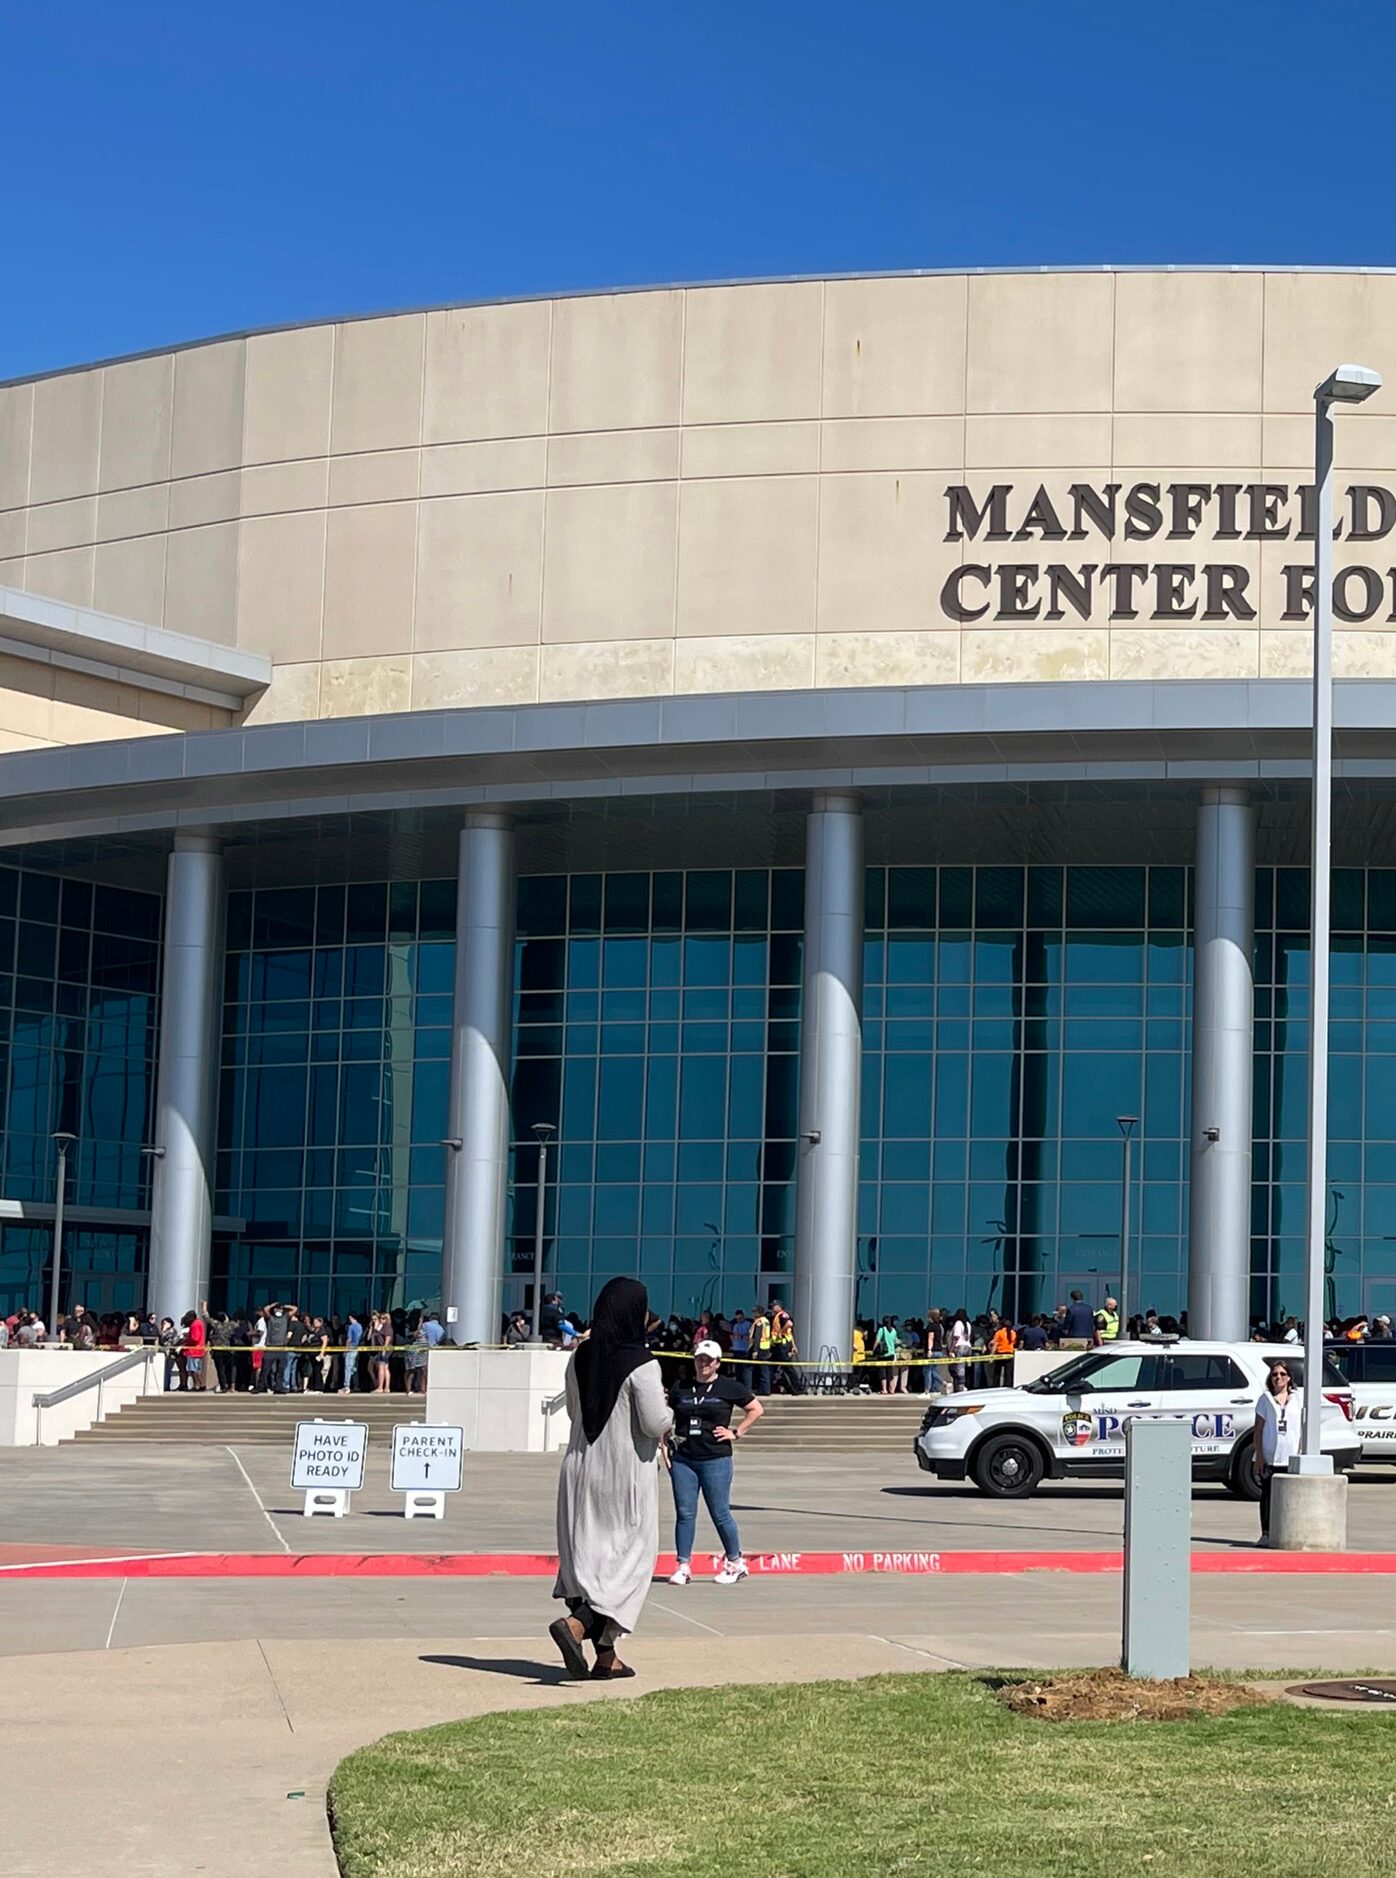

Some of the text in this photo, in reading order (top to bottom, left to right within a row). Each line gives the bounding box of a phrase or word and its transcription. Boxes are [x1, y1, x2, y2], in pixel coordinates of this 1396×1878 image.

[939, 563, 1257, 622] CENTER
[313, 1435, 348, 1447] HAVE
[402, 1436, 454, 1446] PARENT
[300, 1450, 360, 1463] PHOTO ID
[399, 1447, 457, 1458] CHECK-IN
[306, 1465, 349, 1477] READY
[760, 1553, 940, 1572] LANE NO PARKING
